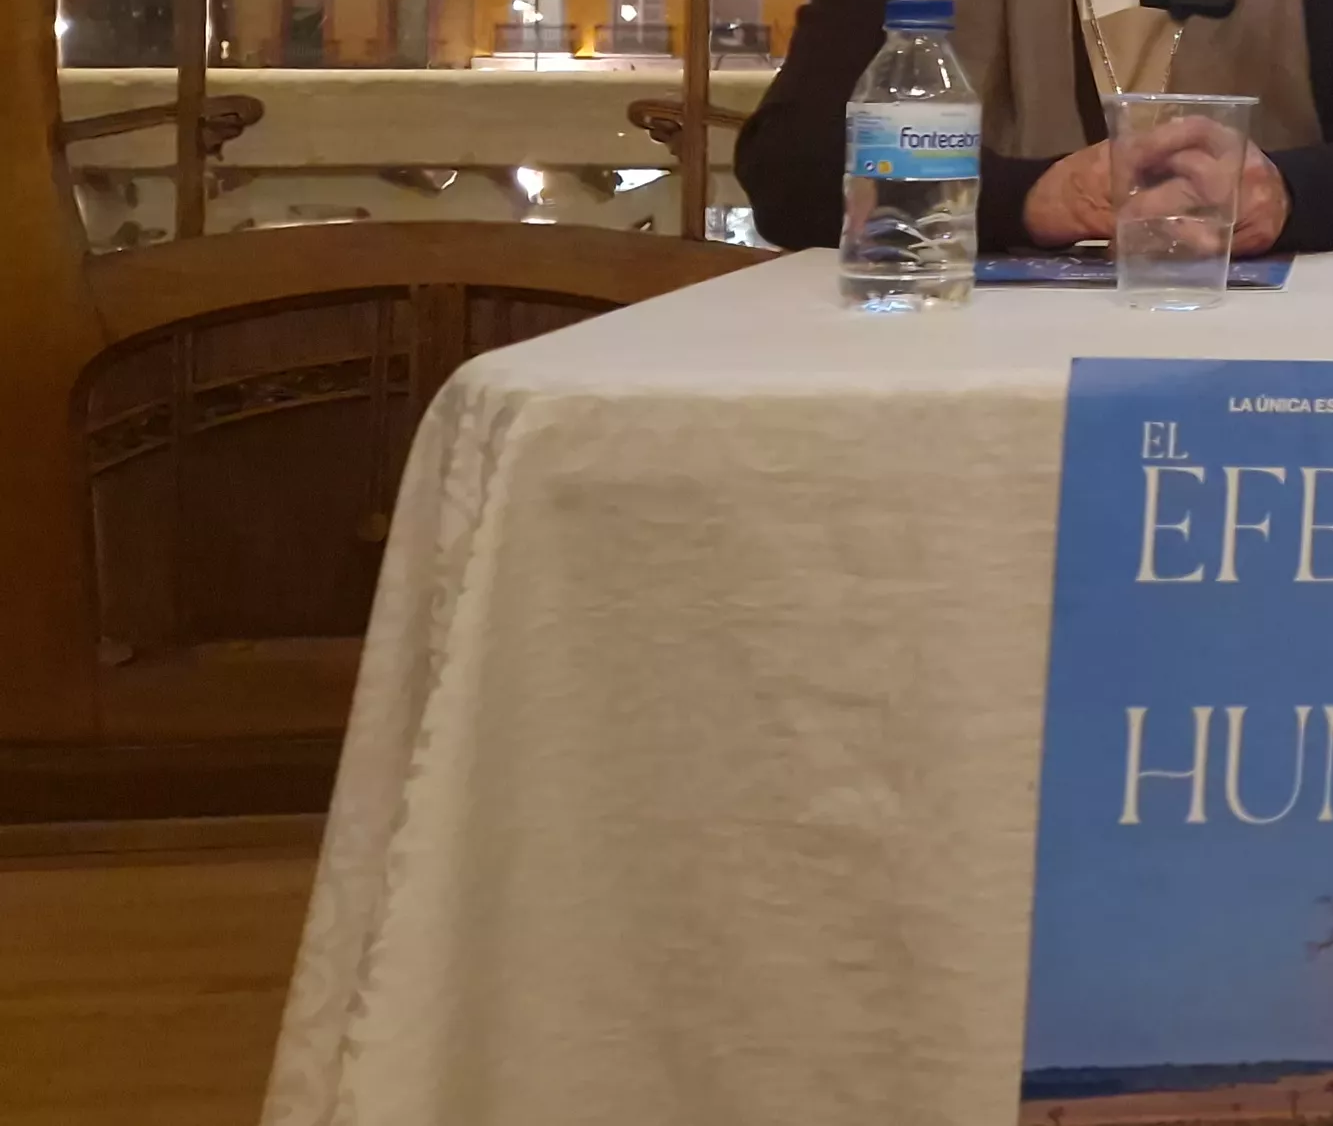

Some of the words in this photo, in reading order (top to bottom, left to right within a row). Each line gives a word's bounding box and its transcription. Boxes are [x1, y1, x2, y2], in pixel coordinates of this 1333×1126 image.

[1229, 397, 1253, 413] LA
[1256, 393, 1311, 413] ÚNICA
[1141, 421, 1189, 460] EL
